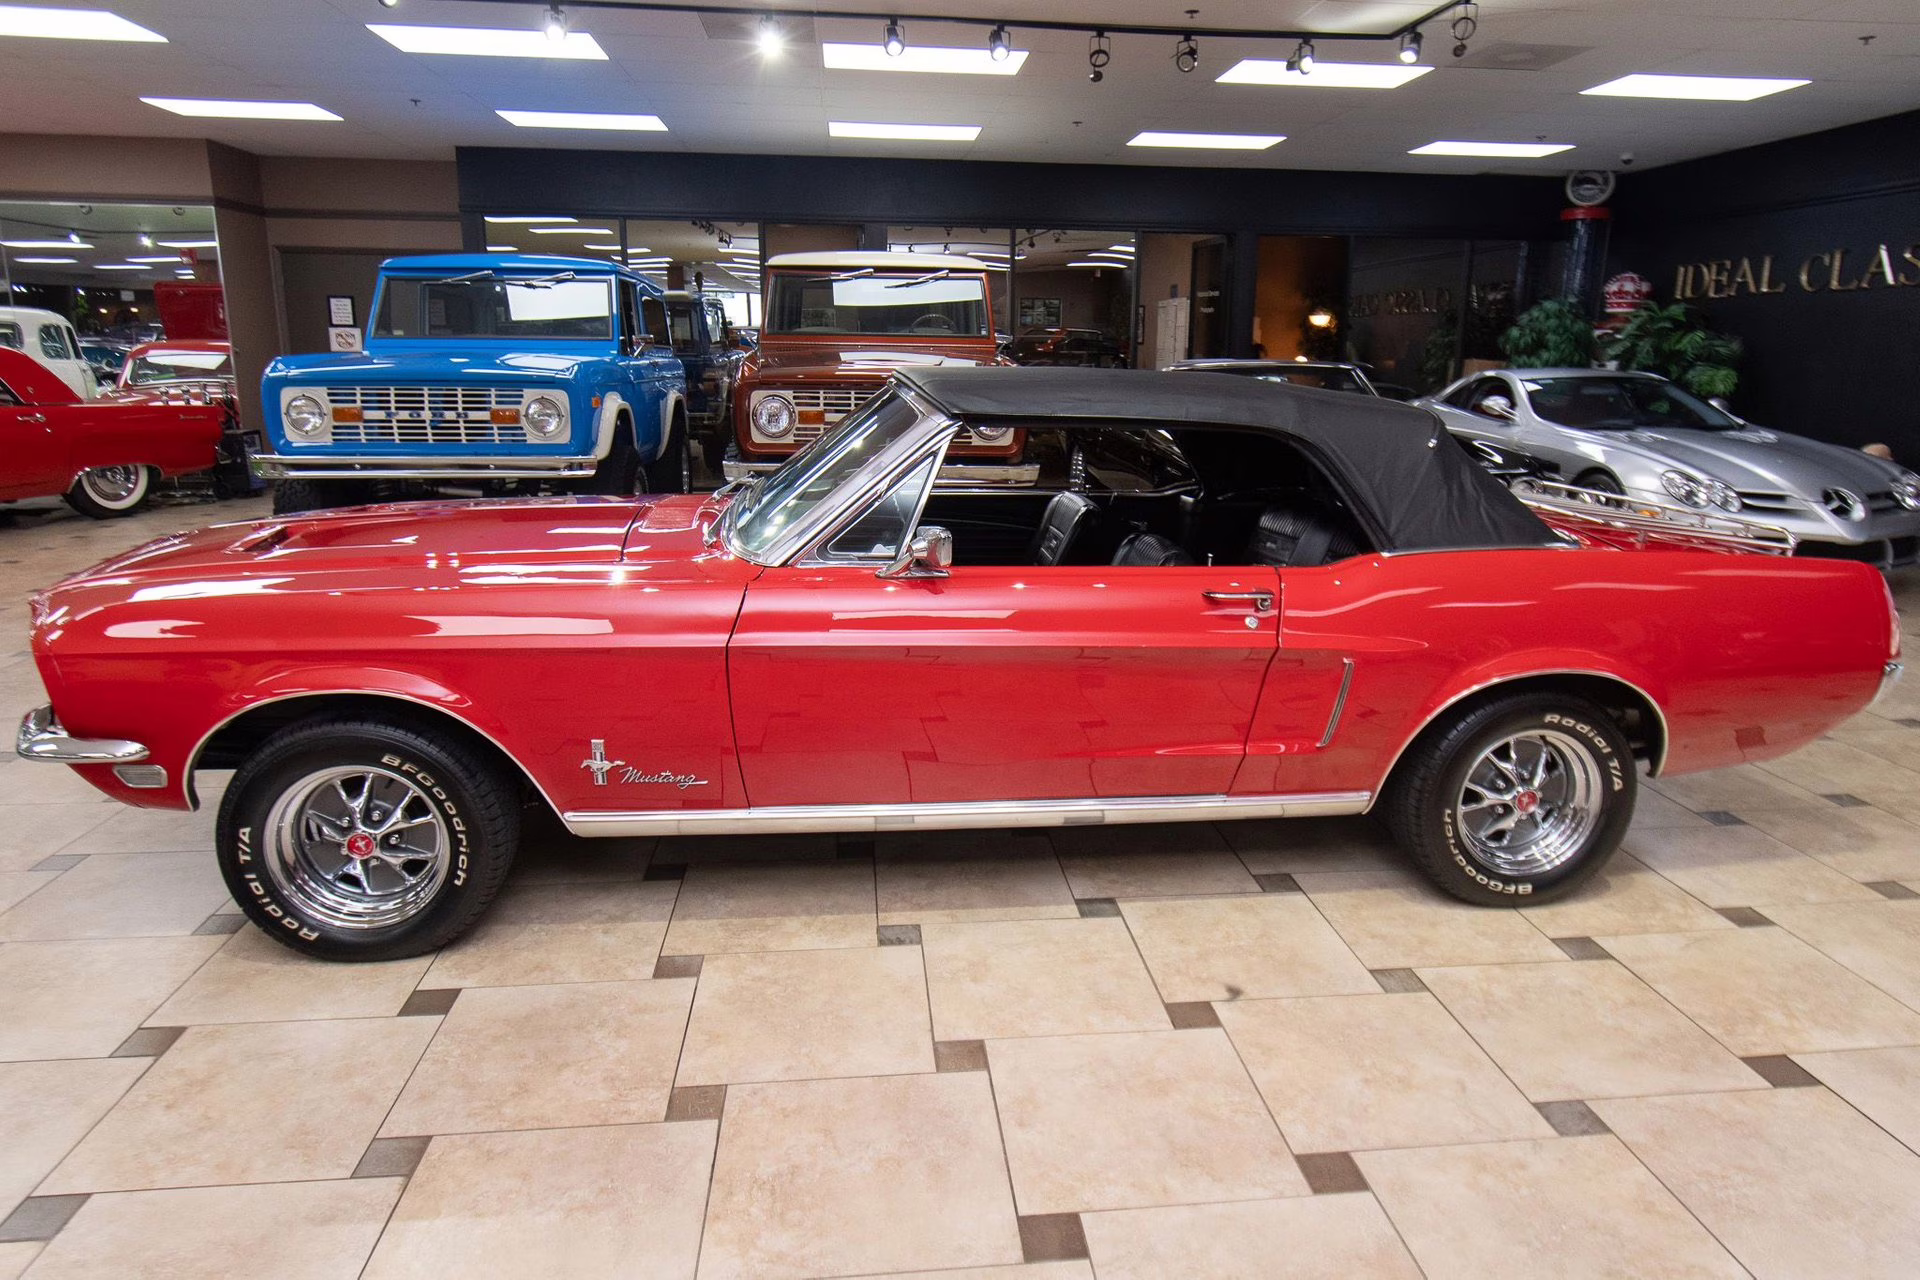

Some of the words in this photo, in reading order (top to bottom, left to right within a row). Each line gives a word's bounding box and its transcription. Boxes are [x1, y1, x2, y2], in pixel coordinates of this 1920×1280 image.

[1675, 255, 1786, 300] IDEAL
[384, 411, 470, 419] FORD
[1544, 713, 1612, 754] Radial
[1608, 757, 1624, 792] T/A
[619, 766, 709, 790] Mustang
[381, 753, 470, 887] BFGoodrich
[238, 826, 252, 865] T/A
[244, 872, 321, 942] Radial
